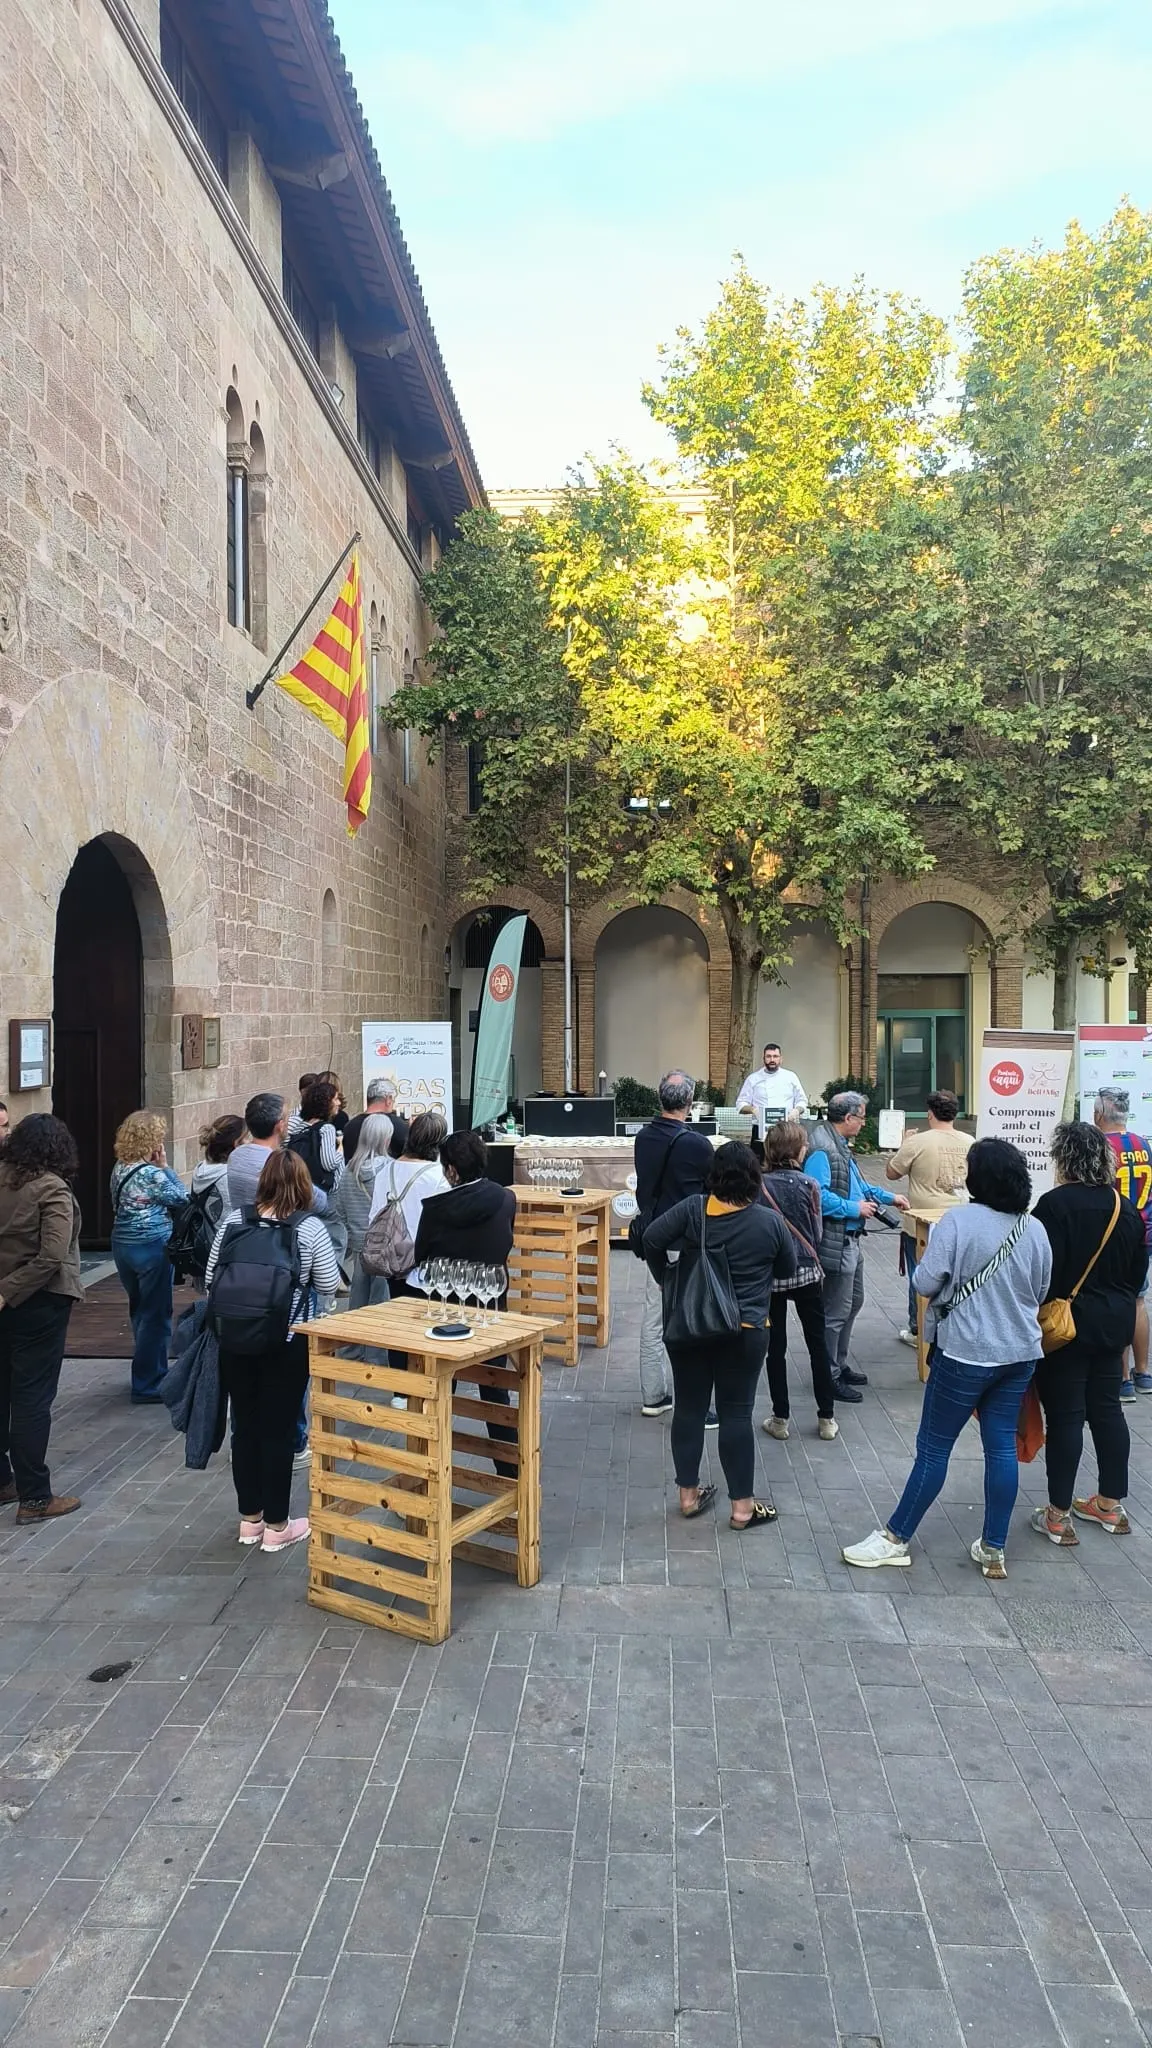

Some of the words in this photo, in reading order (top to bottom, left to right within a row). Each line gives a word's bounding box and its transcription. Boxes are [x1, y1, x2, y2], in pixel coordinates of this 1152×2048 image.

[399, 1079, 446, 1098] GAS
[1002, 1121, 1026, 1130] amb
[1029, 1121, 1041, 1130] el
[1120, 1149, 1149, 1165] EDRO
[1115, 1164, 1152, 1210] 17
